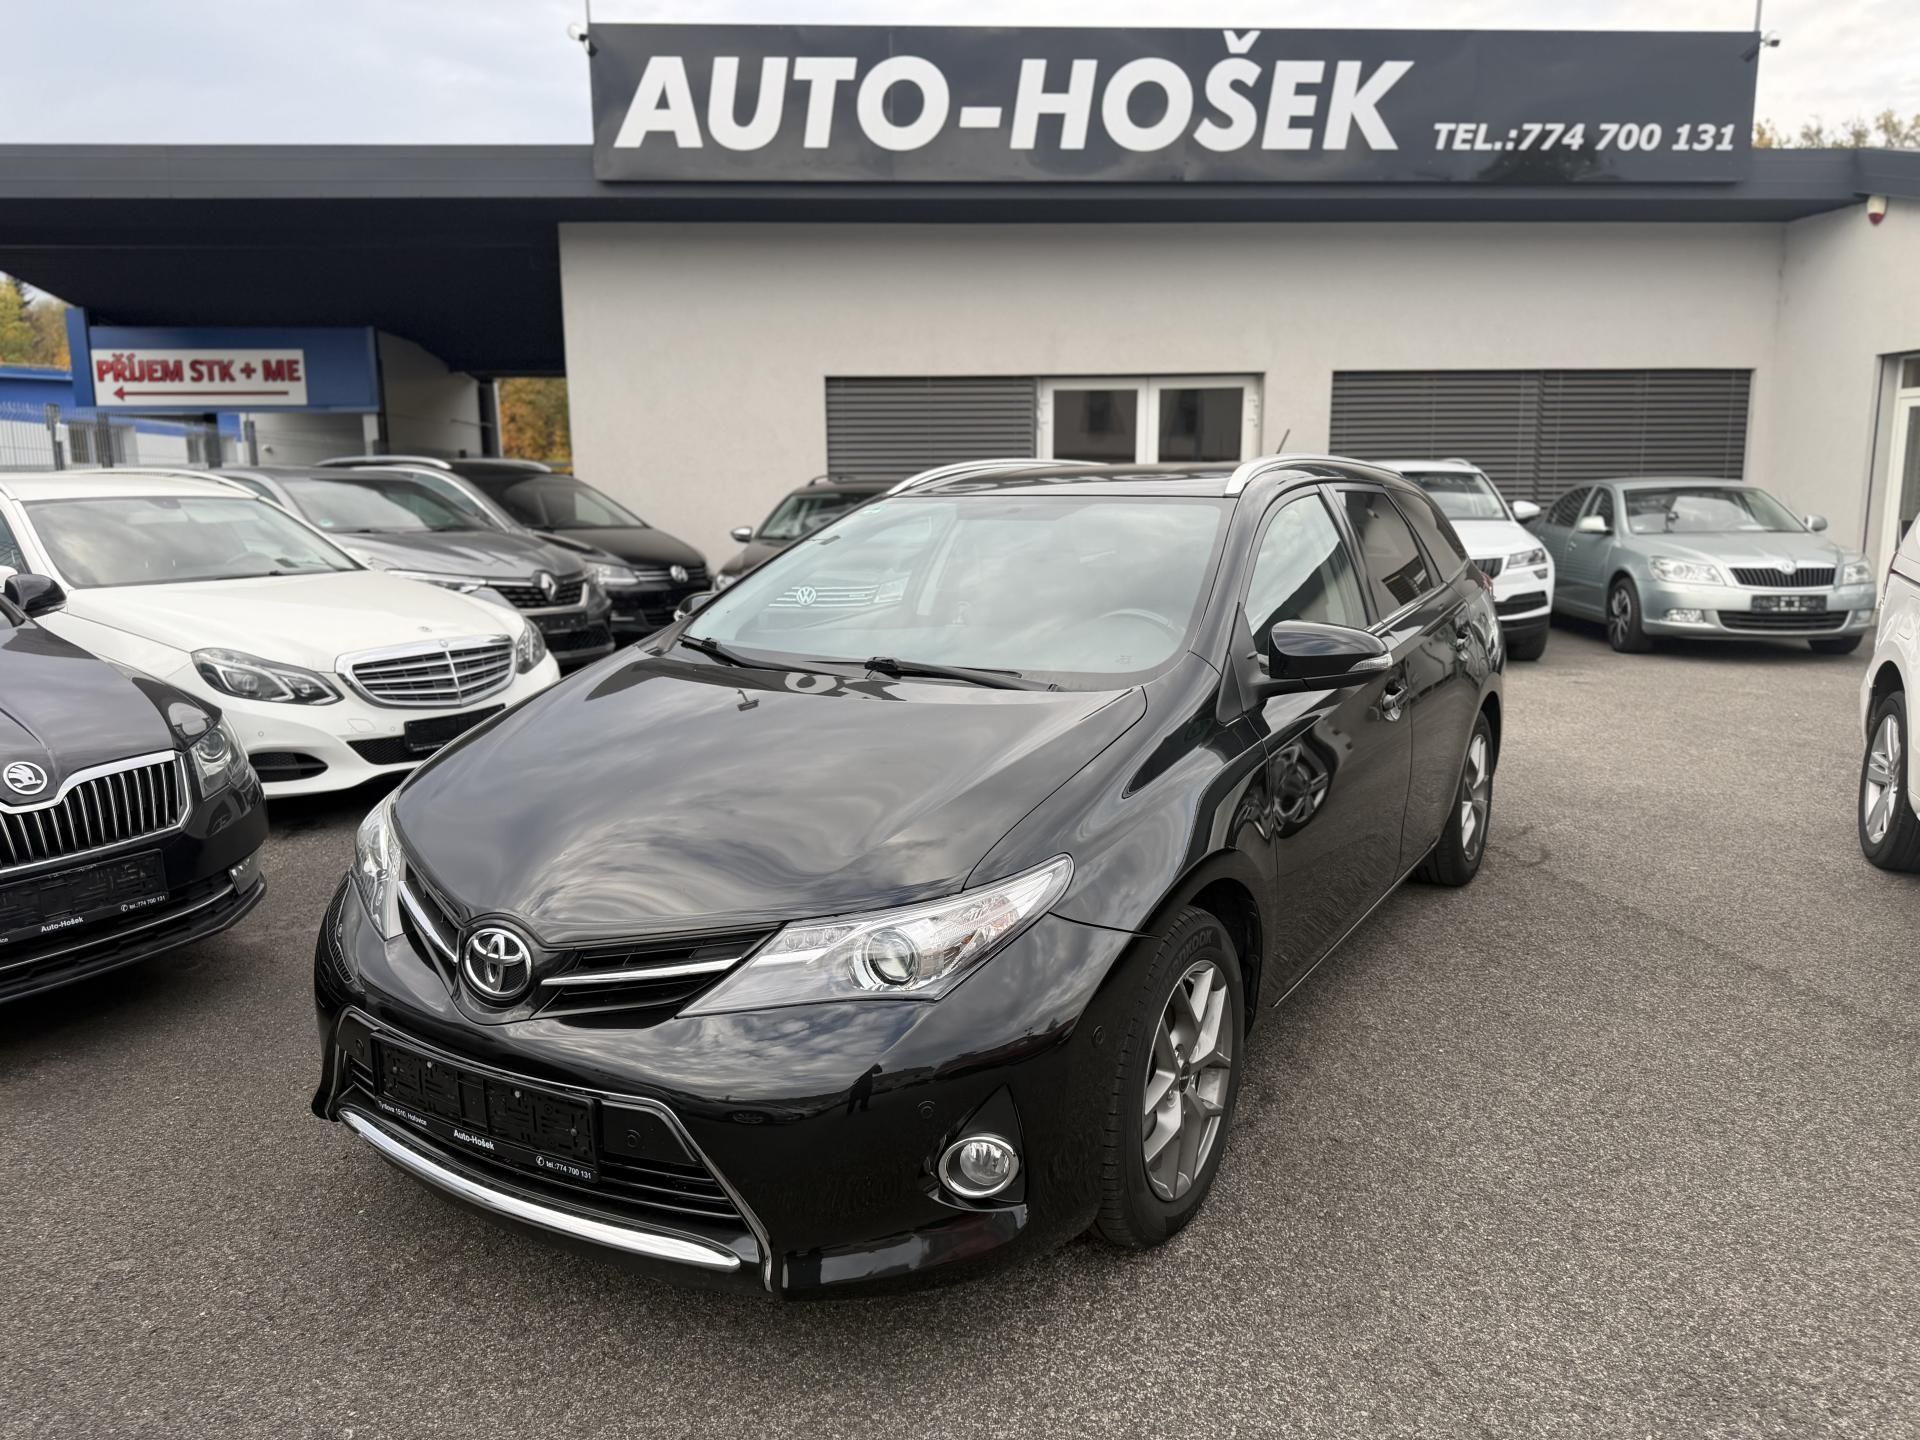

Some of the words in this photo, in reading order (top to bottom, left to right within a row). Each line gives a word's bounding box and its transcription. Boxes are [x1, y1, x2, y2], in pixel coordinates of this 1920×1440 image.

[614, 30, 1415, 151] AUTO-HOŠEK
[1433, 123, 1585, 150] TEL.:774
[1595, 123, 1661, 150] 700
[1671, 123, 1735, 150] 131
[96, 353, 184, 382] PŘÍJEM
[189, 359, 236, 382] STK
[262, 359, 302, 382] ME
[568, 1166, 579, 1176] 700
[581, 1170, 591, 1180] 131
